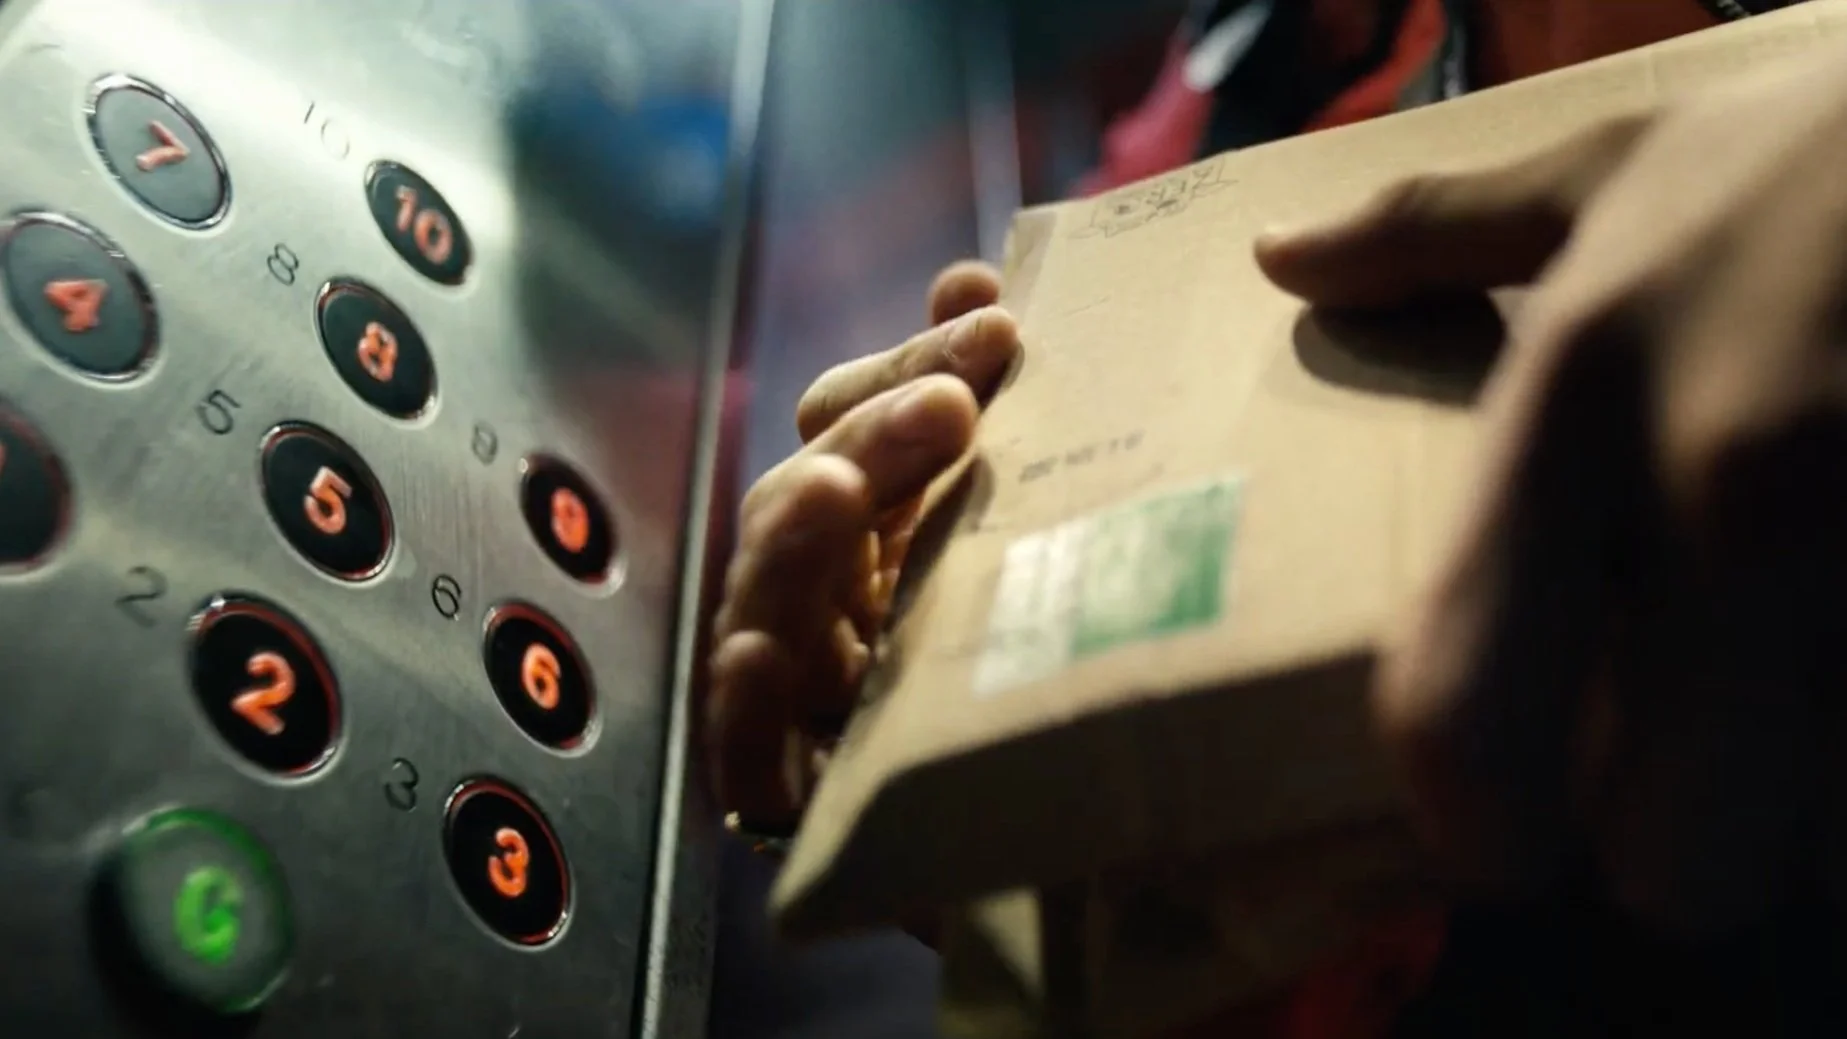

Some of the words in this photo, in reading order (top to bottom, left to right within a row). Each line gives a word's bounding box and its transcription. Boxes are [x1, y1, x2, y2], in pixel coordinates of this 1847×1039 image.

[136, 120, 190, 171] 7
[396, 185, 452, 264] 10
[267, 243, 299, 286] 8
[44, 278, 108, 332] 4
[358, 321, 397, 382] 8
[197, 390, 241, 434] 5
[305, 466, 352, 534] 5
[117, 565, 168, 626] 2
[432, 574, 461, 620] 6
[232, 651, 295, 734] 2
[522, 643, 560, 709] 6
[385, 758, 419, 811] 3
[489, 828, 530, 897] 3
[174, 868, 242, 965] G
